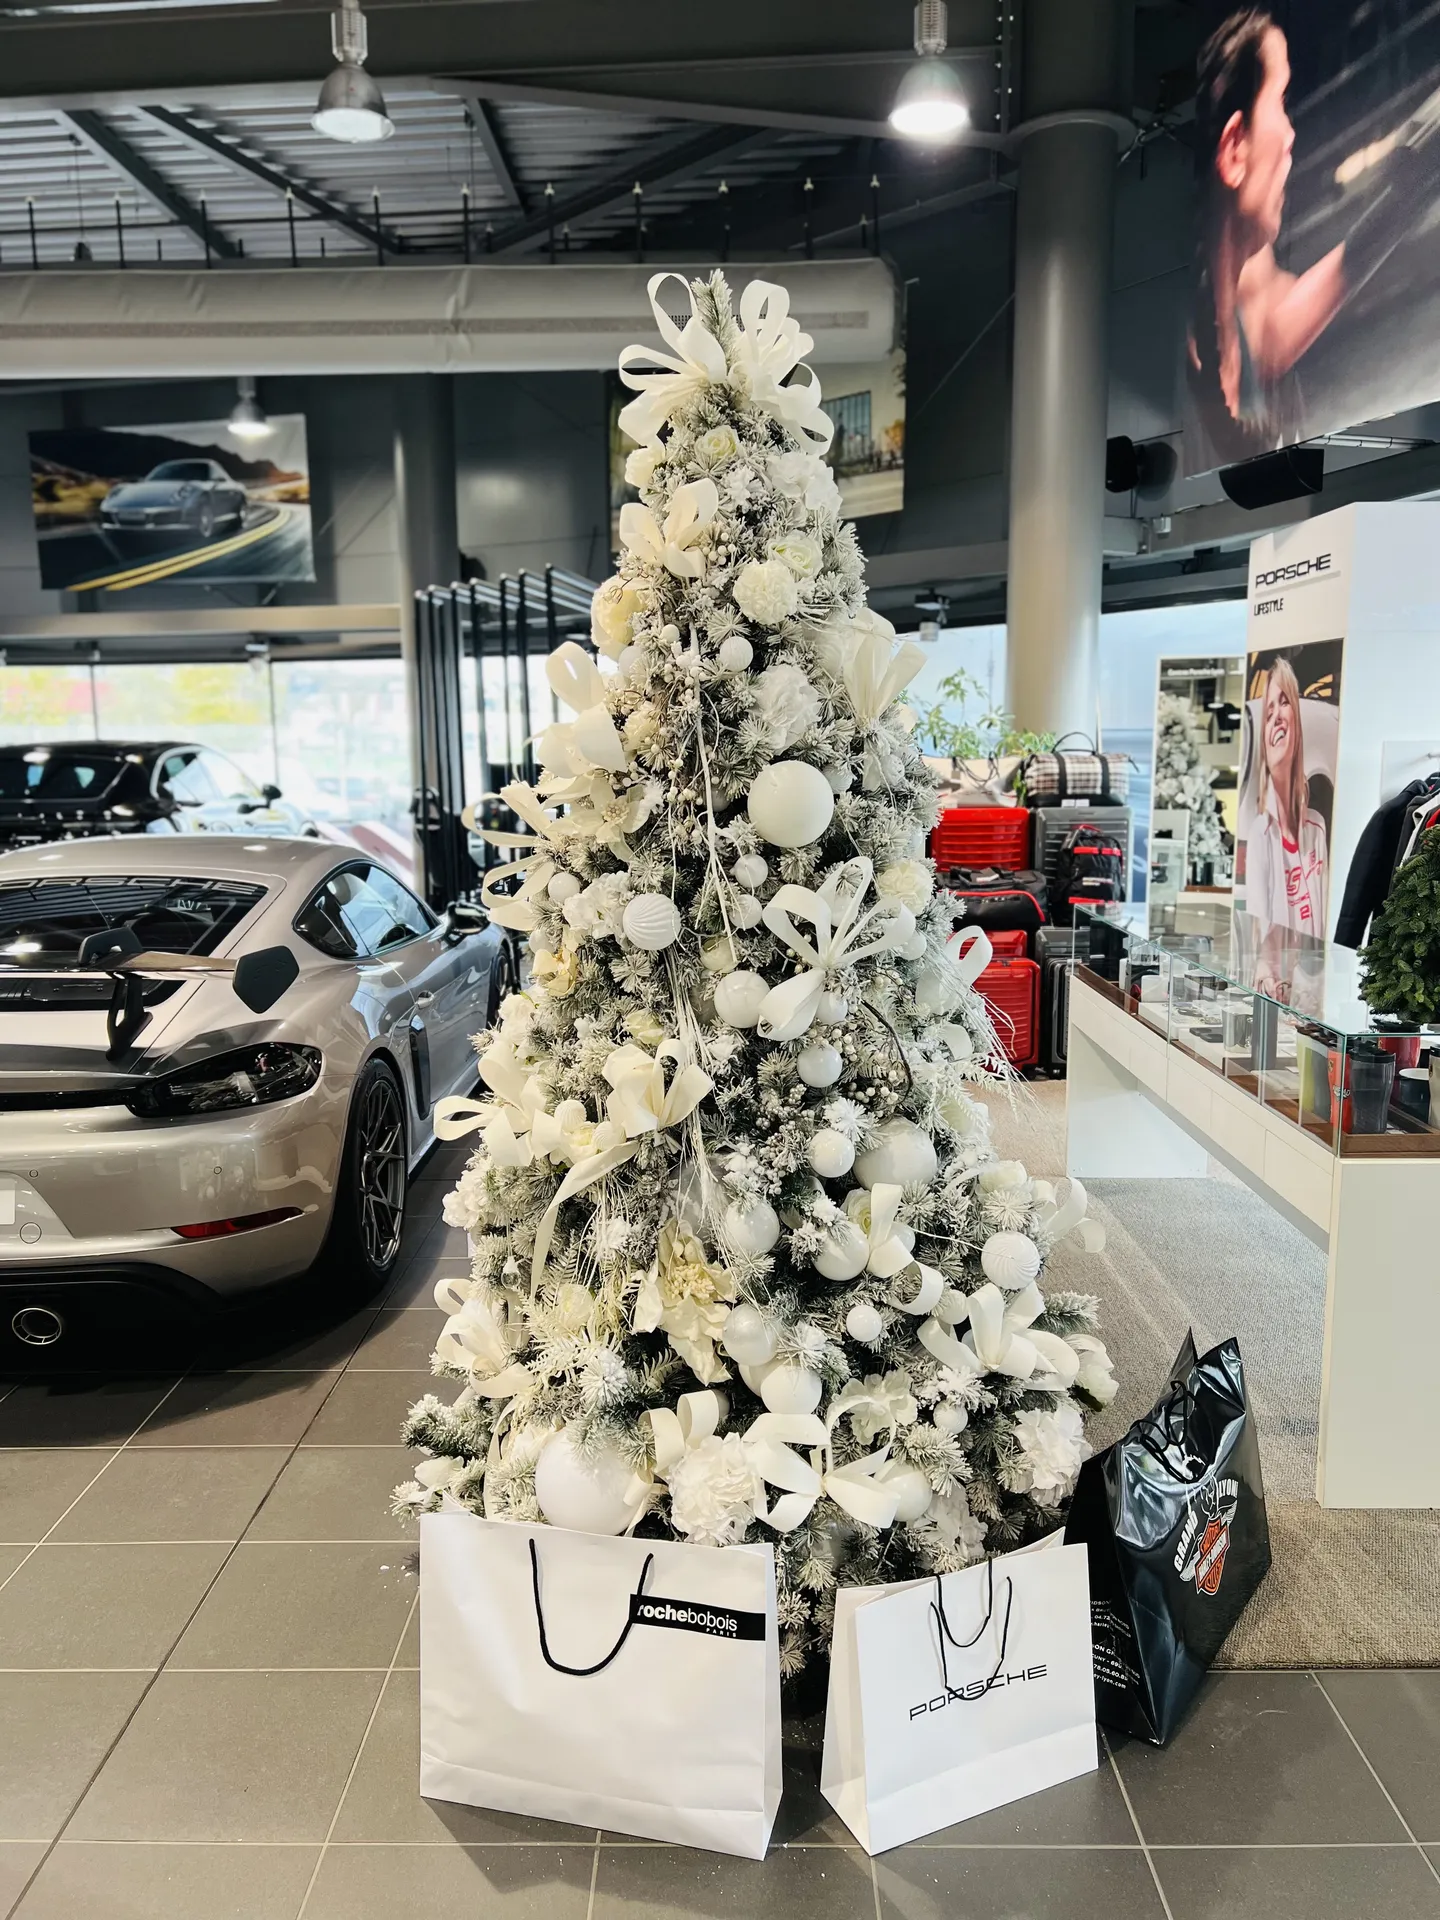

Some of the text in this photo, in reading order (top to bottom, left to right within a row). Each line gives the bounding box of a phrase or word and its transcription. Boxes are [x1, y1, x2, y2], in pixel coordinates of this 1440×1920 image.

[1255, 553, 1331, 588] PORSCHE
[1254, 598, 1284, 616] LIFESTYLE
[0, 877, 259, 895] ORSCHE
[1174, 1510, 1199, 1572] GRAND
[637, 1604, 738, 1632] rochebobois
[706, 1628, 737, 1638] PARIS
[909, 1664, 1047, 1721] PORSCHE
